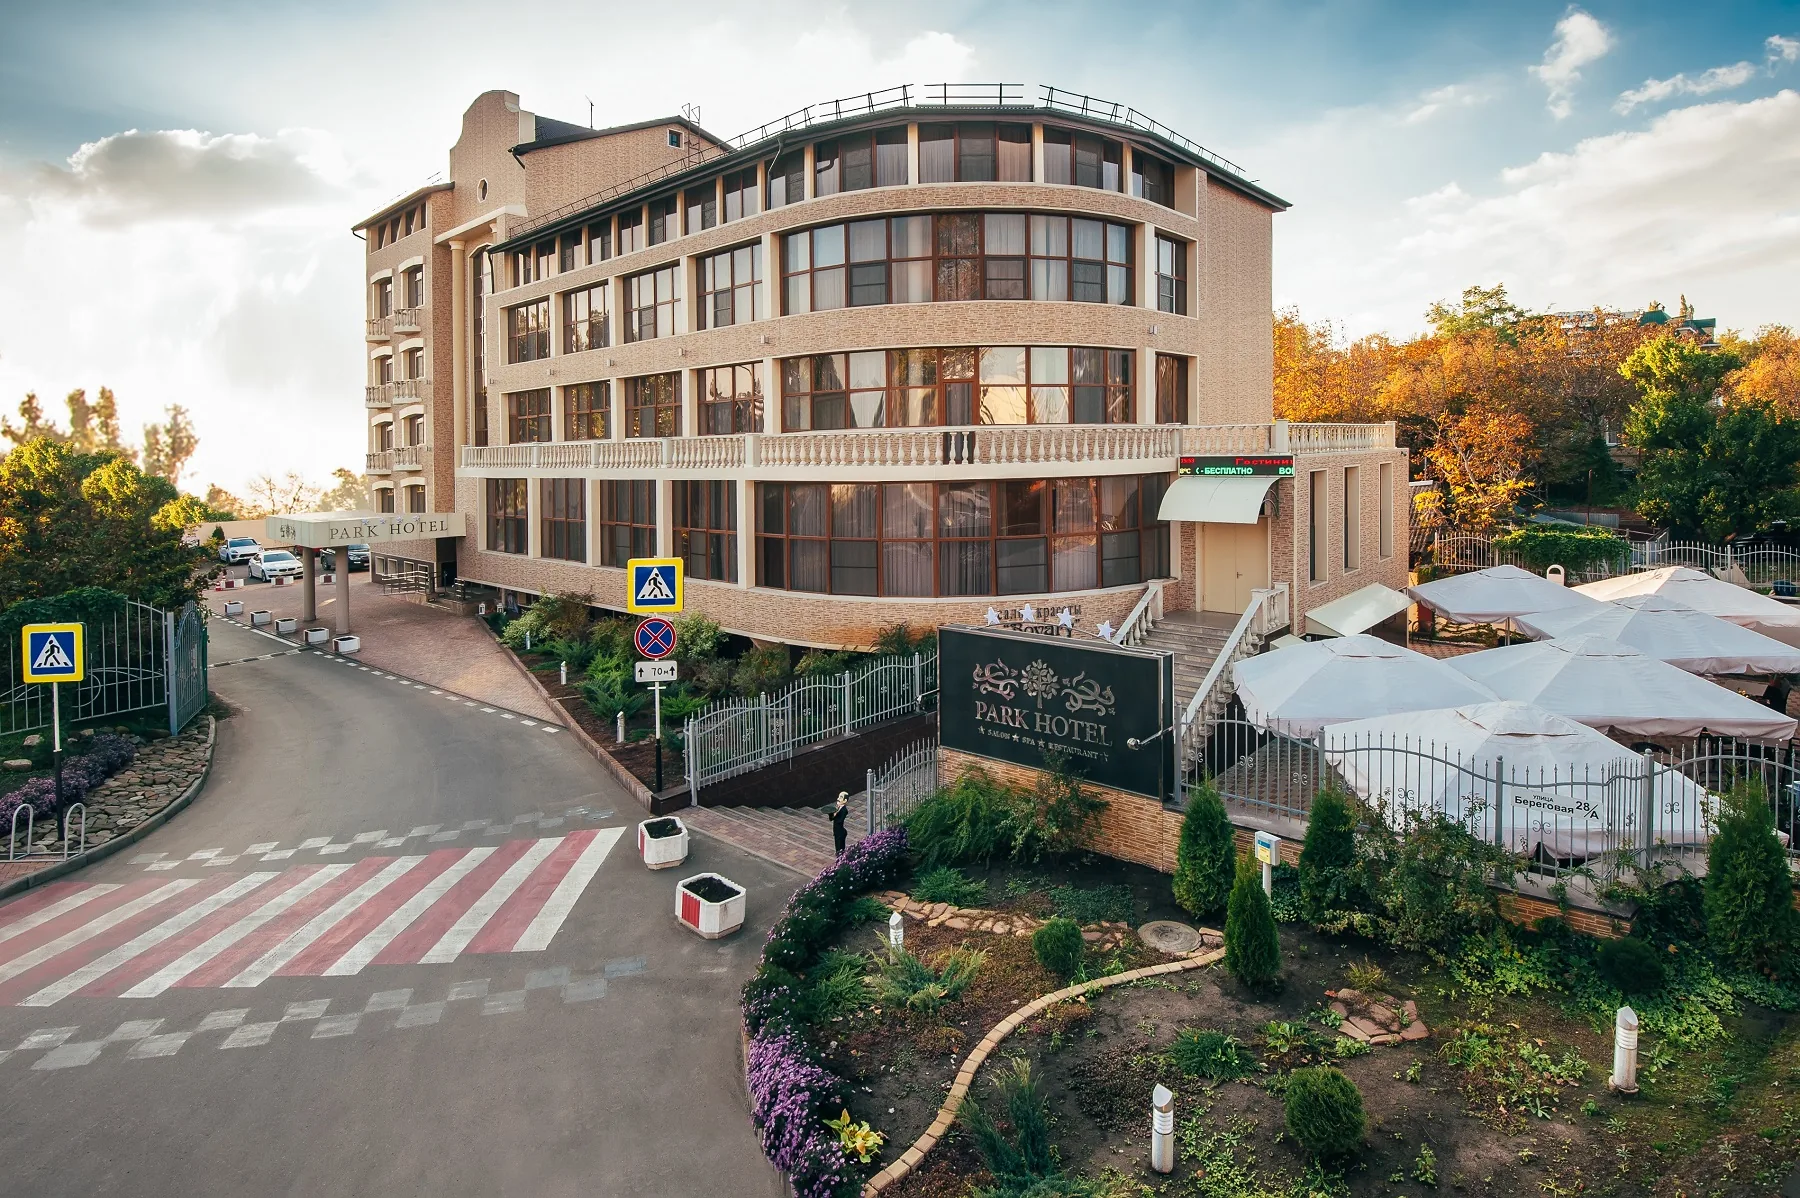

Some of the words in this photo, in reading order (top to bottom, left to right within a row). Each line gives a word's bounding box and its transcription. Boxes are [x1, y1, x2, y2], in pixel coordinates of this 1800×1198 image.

[1204, 467, 1253, 475] БЕСПЛАТНО
[329, 524, 380, 540] PARK
[389, 520, 449, 535] HOTEL
[974, 701, 1029, 730] PARK
[1034, 711, 1113, 747] HOTEL
[987, 729, 1011, 741] SALON
[1021, 736, 1036, 746] SPA
[1047, 742, 1099, 760] RESTAURANT
[1514, 795, 1574, 814] Береговая
